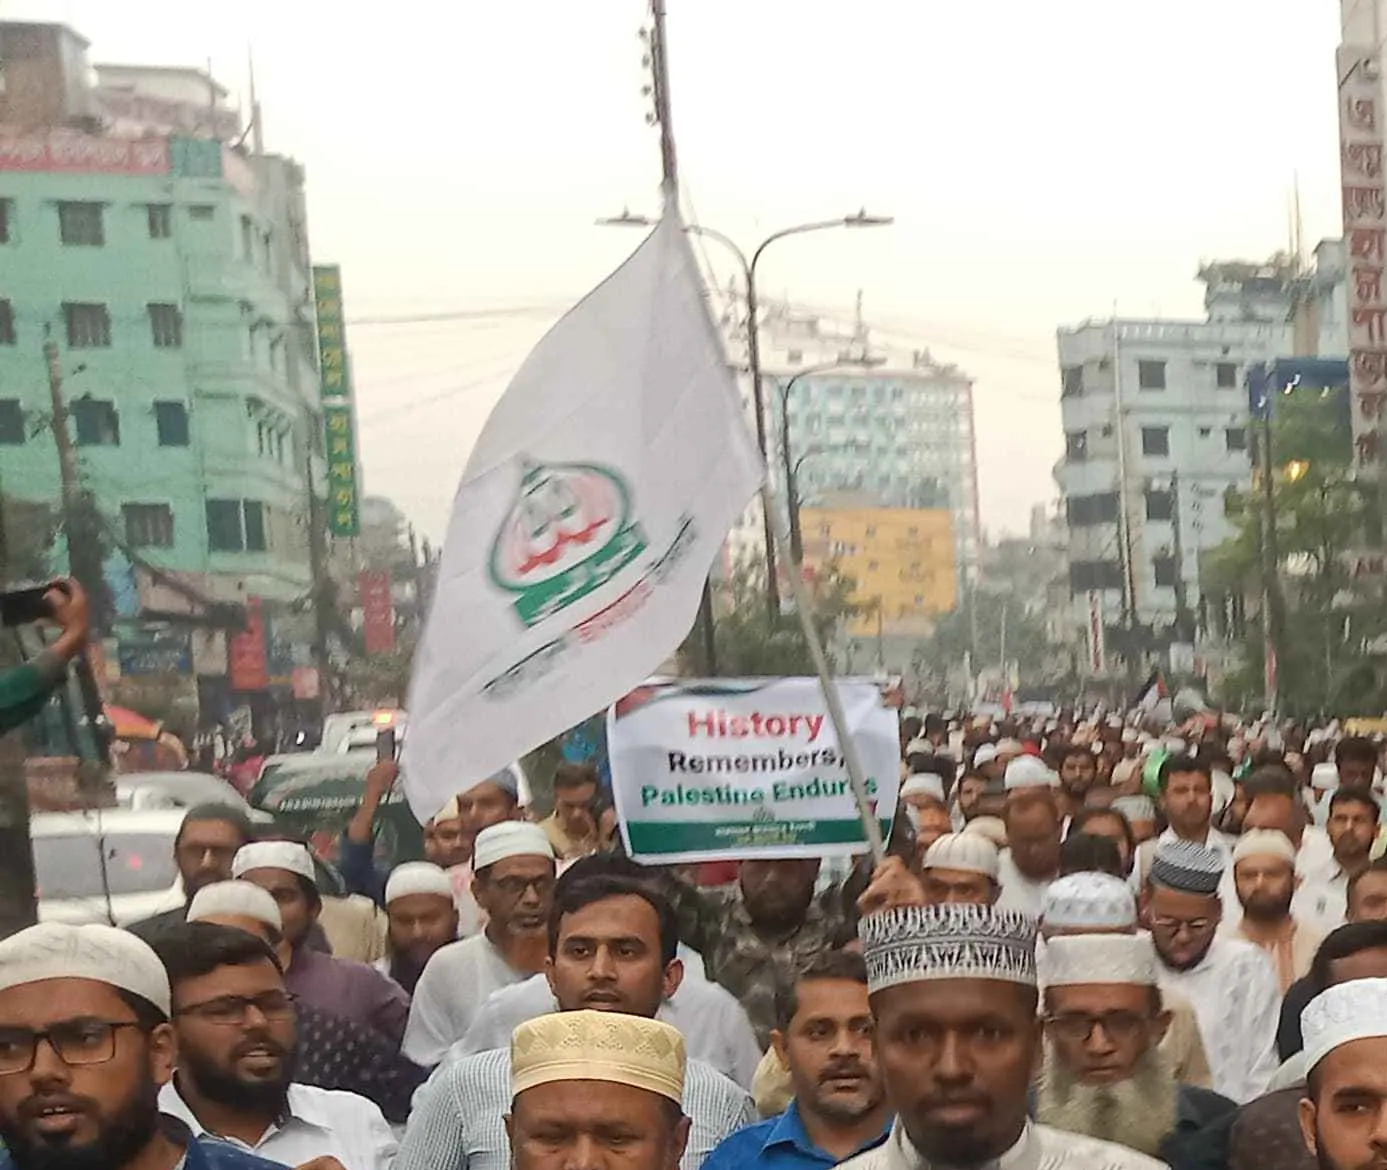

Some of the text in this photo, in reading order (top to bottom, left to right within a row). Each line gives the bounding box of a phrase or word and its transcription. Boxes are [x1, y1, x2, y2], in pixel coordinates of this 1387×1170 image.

[687, 709, 824, 742] History
[668, 746, 845, 775] Remembers,
[641, 777, 878, 807] Palestine Endurs
